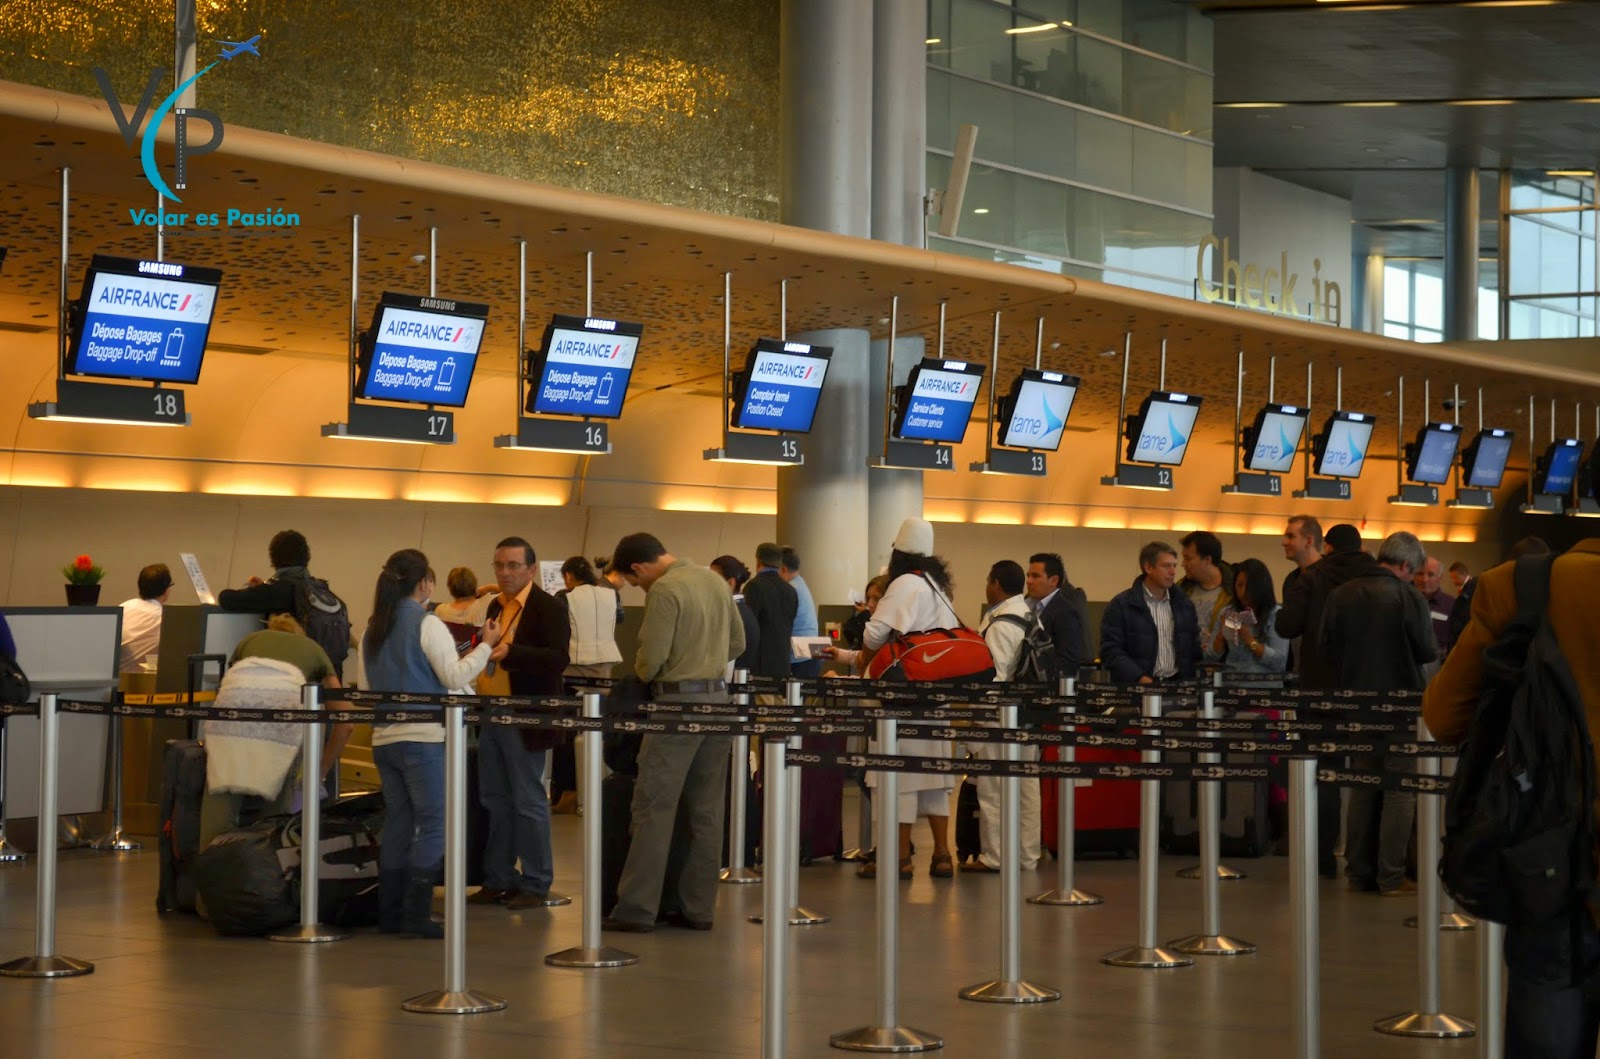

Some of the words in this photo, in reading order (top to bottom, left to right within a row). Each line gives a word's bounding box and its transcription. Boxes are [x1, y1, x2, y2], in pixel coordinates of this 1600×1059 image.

[138, 261, 183, 276] SAMSUNG
[1197, 233, 1298, 316] Check
[1312, 257, 1341, 323] in
[420, 297, 456, 311] SAMSUNG
[91, 322, 125, 341] Dépose
[125, 325, 162, 345] Bagages
[87, 342, 123, 363] Baggage
[123, 345, 158, 365] Drop-off
[378, 352, 407, 369] Dépose
[407, 355, 438, 373] Bagages
[374, 369, 404, 388] Baggage
[404, 372, 433, 389] Drop-off
[547, 369, 572, 385] Dépose
[571, 371, 598, 388] Bagages
[543, 385, 570, 403] Baggage
[569, 388, 594, 403] Drop-off
[153, 394, 177, 416] 18
[746, 402, 766, 415] Position
[766, 404, 784, 417] Closed
[427, 415, 448, 436] 17
[1010, 413, 1041, 435] tame
[585, 426, 603, 446] 16
[1138, 432, 1167, 451] tame
[781, 440, 797, 458] 15
[935, 448, 949, 465] 14
[1254, 442, 1279, 459] tame
[1323, 449, 1347, 466] tame
[1031, 456, 1043, 471] 13
[1158, 470, 1170, 485] 12
[1269, 478, 1279, 492] 11
[1339, 483, 1349, 496] 10
